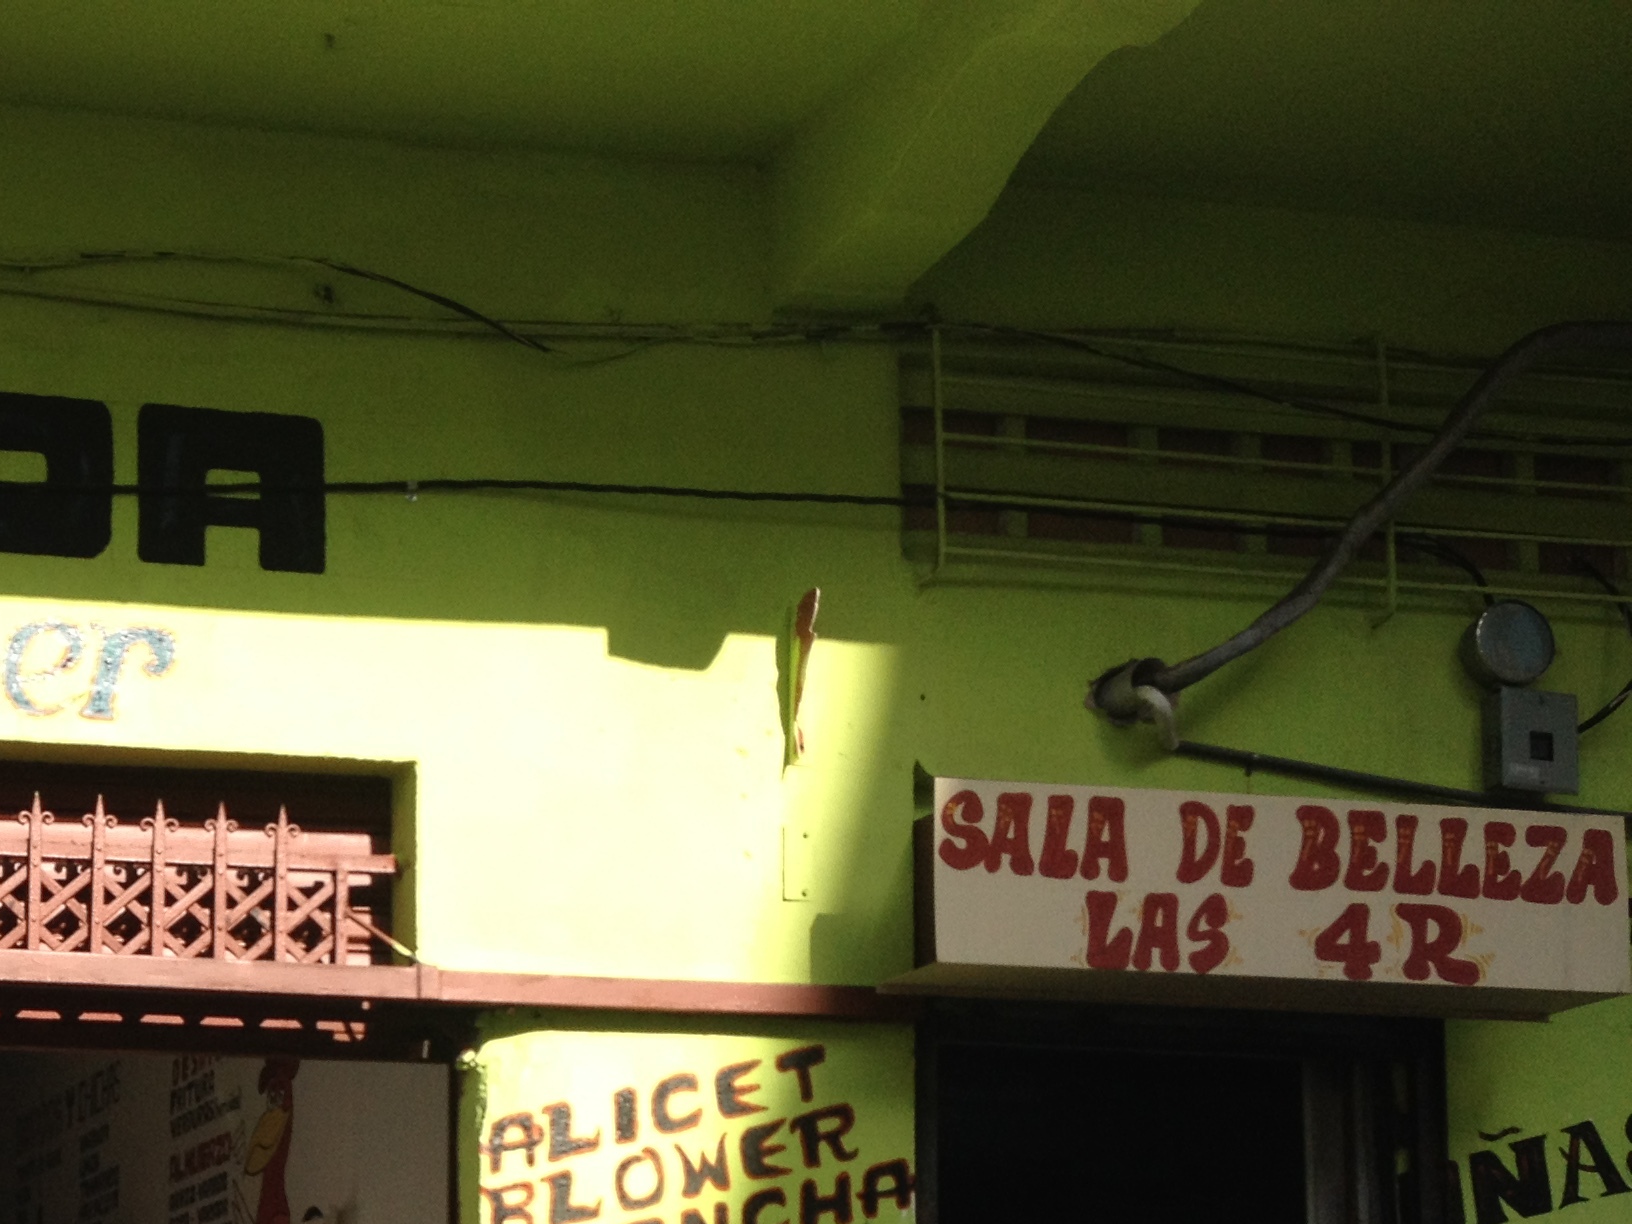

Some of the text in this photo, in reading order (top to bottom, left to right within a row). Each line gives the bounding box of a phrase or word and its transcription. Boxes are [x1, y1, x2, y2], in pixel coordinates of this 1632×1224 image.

[938, 789, 1620, 906] SALA DE BELLEZA
[1084, 890, 1482, 987] LAS 4R
[480, 1044, 827, 1174] ALICET
